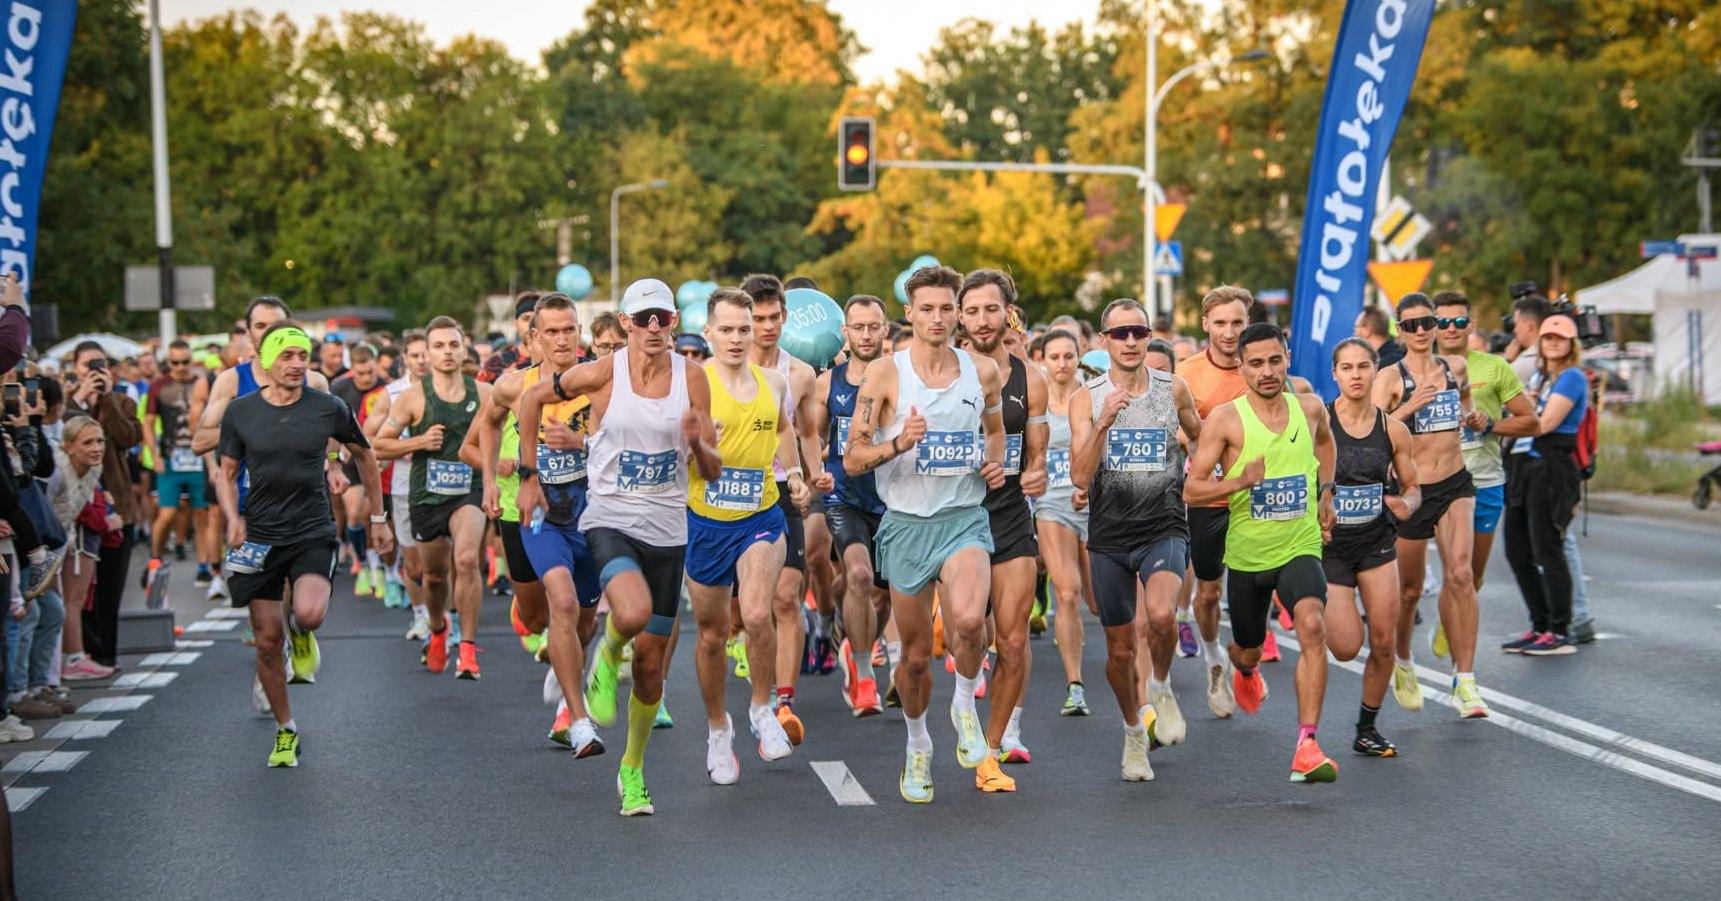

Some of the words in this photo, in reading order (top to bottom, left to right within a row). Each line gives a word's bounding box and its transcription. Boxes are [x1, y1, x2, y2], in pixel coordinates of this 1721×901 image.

[0, 1, 42, 314] ałołęka
[791, 302, 828, 329] 35:00
[1427, 402, 1452, 417] 755
[928, 445, 964, 460] 1092
[1123, 443, 1152, 456] 760
[548, 454, 575, 469] 673
[635, 462, 664, 479] 797
[718, 481, 750, 496] 1188
[1265, 491, 1295, 505] 800
[1339, 498, 1371, 511] 1073
